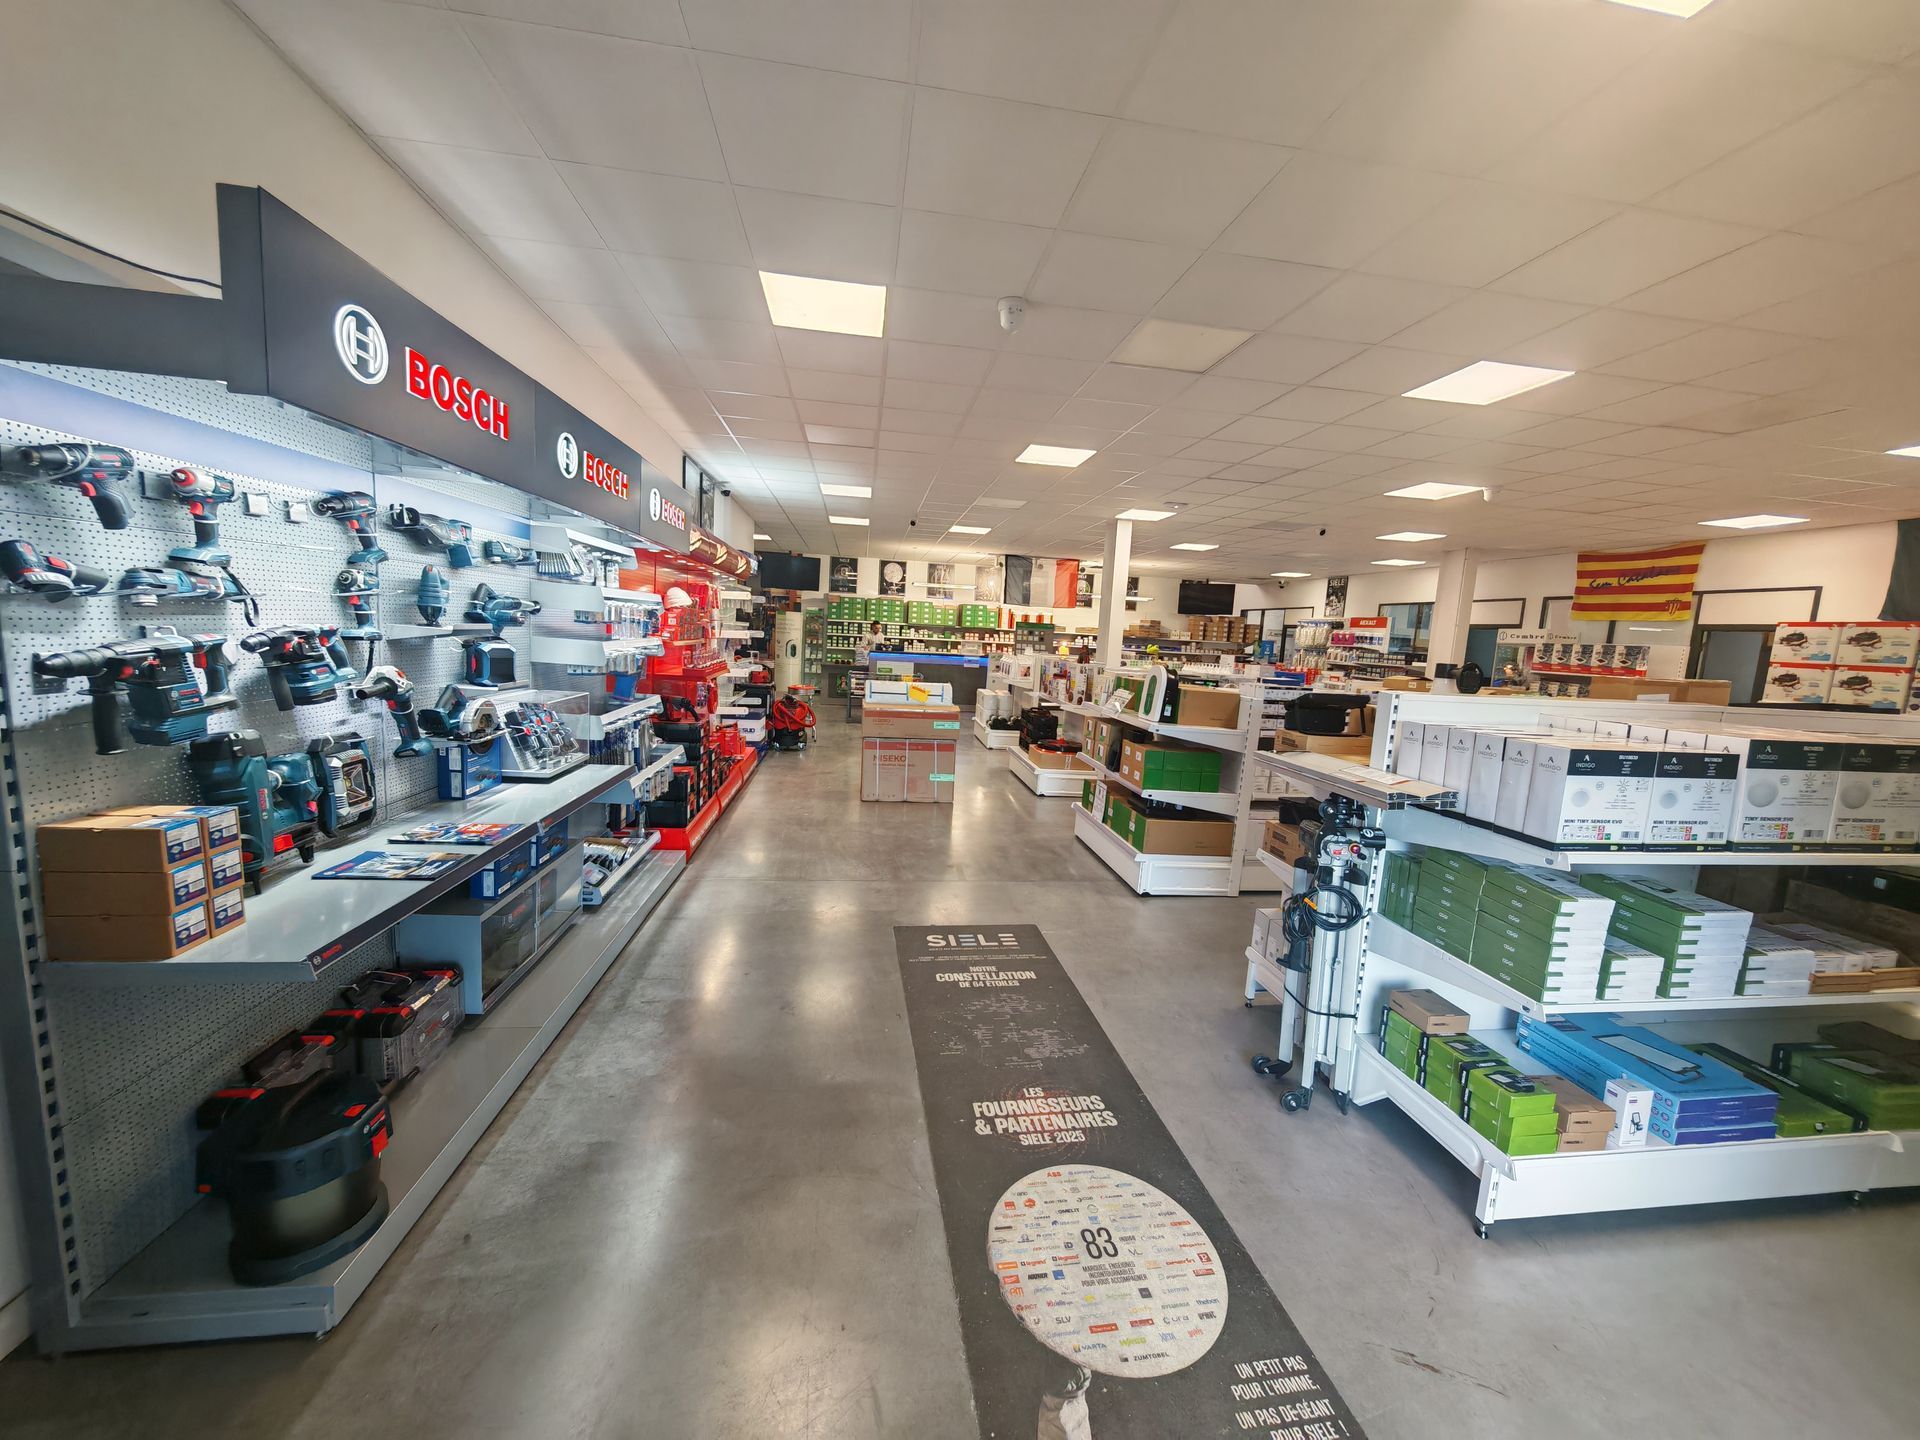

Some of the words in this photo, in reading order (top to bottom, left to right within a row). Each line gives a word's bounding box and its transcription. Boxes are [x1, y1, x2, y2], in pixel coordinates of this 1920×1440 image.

[405, 346, 509, 441] BOSCH
[583, 450, 629, 501] BOSCH
[661, 498, 686, 531] BOSCH
[1329, 579, 1345, 587] SIELE
[1477, 750, 1497, 758] INDIGO
[1508, 756, 1529, 765] INDIGO
[1538, 762, 1561, 771] INDIGO
[926, 933, 1018, 947] SIELE
[935, 971, 1037, 982] CONSTELLATION
[986, 979, 1020, 987] ÉTOILES
[1023, 1087, 1044, 1098] LES
[972, 1095, 1105, 1118] FOURNISSEURS
[974, 1118, 992, 1135] &
[994, 1110, 1118, 1134] PARTENAIRES
[1019, 1132, 1052, 1146] SIELE
[1052, 1130, 1086, 1143] 2025
[1080, 1227, 1119, 1260] 83
[1081, 1279, 1096, 1287] POUR
[1096, 1278, 1110, 1286] VOUS
[1110, 1273, 1148, 1284] ACCOMPAGNER
[1088, 1268, 1136, 1279] INCONTOURNABLES
[1055, 1316, 1071, 1324] SLV
[1133, 1352, 1170, 1361] ZUMTOBEL
[1234, 1362, 1255, 1379] UN
[1252, 1358, 1284, 1377] PETIT
[1282, 1355, 1308, 1372] PAS
[1231, 1382, 1266, 1401] POUR
[1263, 1374, 1321, 1396] L'HOMME,
[1235, 1410, 1257, 1430] UN
[1254, 1406, 1281, 1426] PAS
[1279, 1404, 1298, 1422] DE
[1296, 1398, 1335, 1420] GÉANT
[1270, 1426, 1304, 1440] POUR
[1304, 1421, 1339, 1440] SIELE
[1338, 1419, 1350, 1437] !
